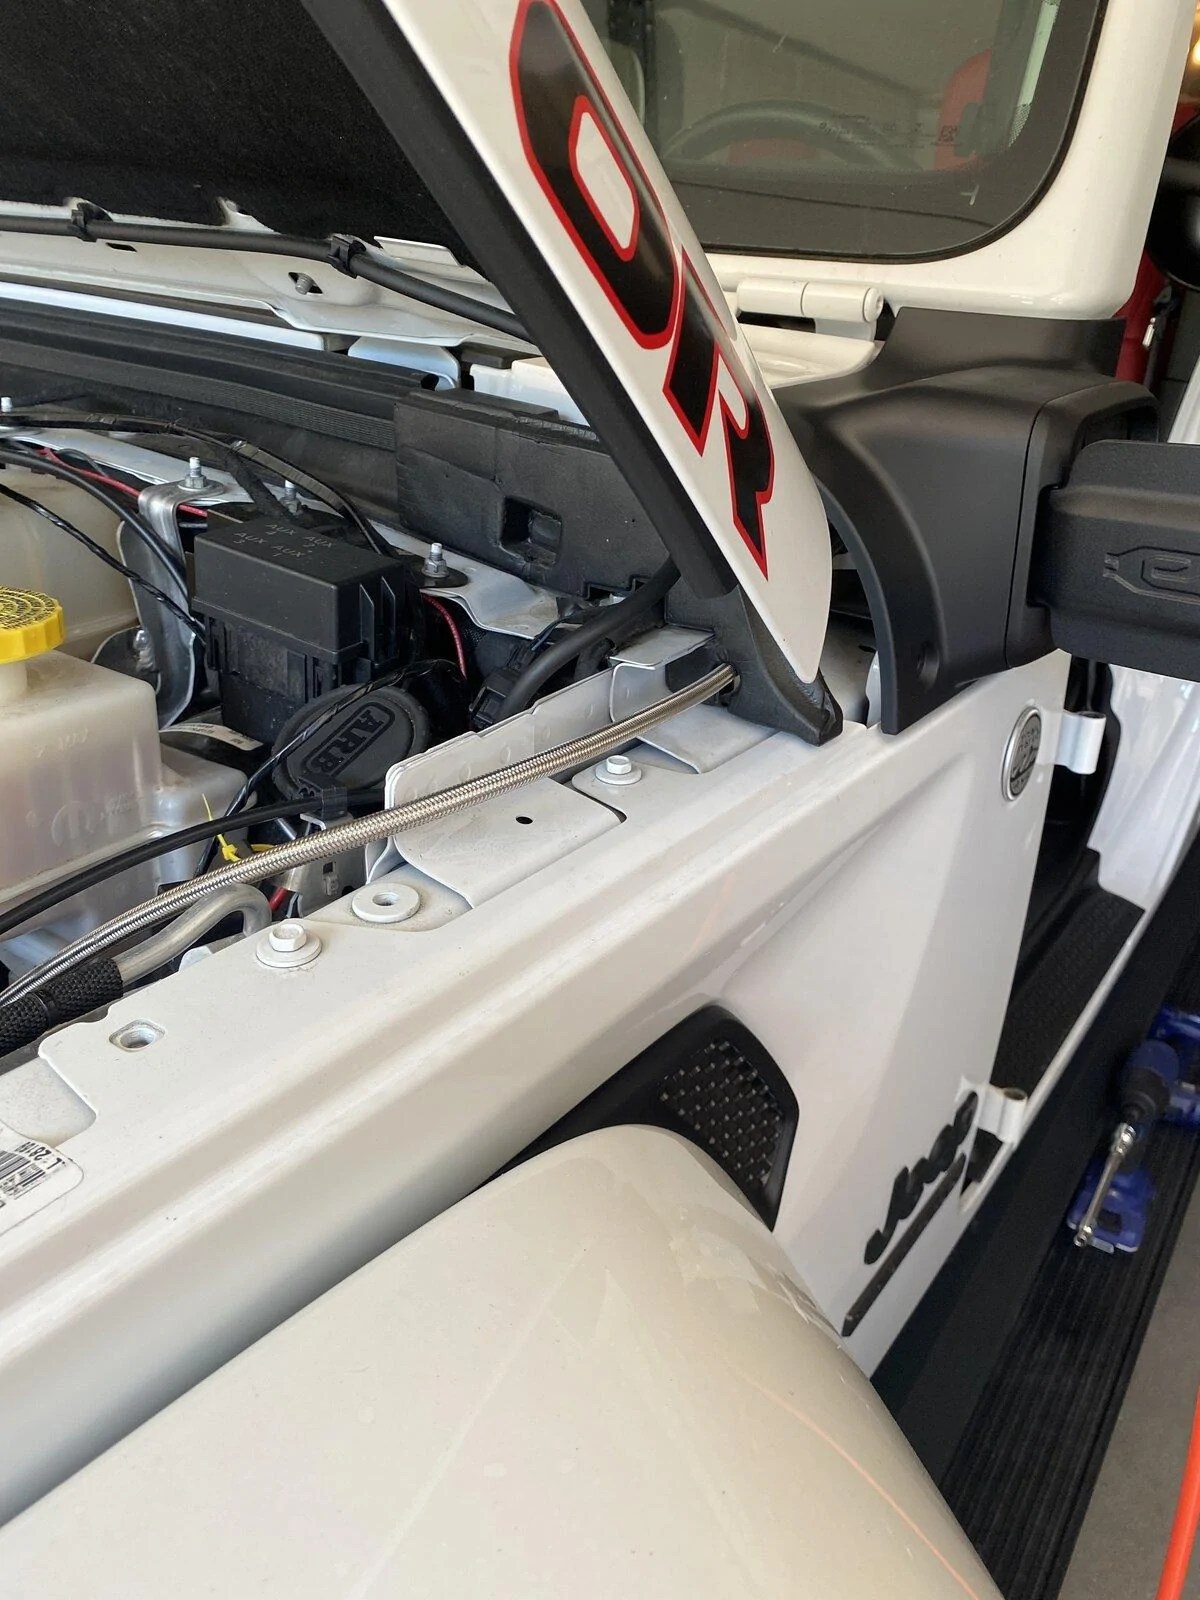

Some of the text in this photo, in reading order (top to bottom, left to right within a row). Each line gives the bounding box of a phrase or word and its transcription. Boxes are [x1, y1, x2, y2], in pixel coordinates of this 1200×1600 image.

[264, 524, 297, 535] AUX
[234, 532, 268, 544] AUX
[302, 536, 334, 548] AUX
[271, 545, 306, 558] AUX
[310, 709, 385, 772] ARB
